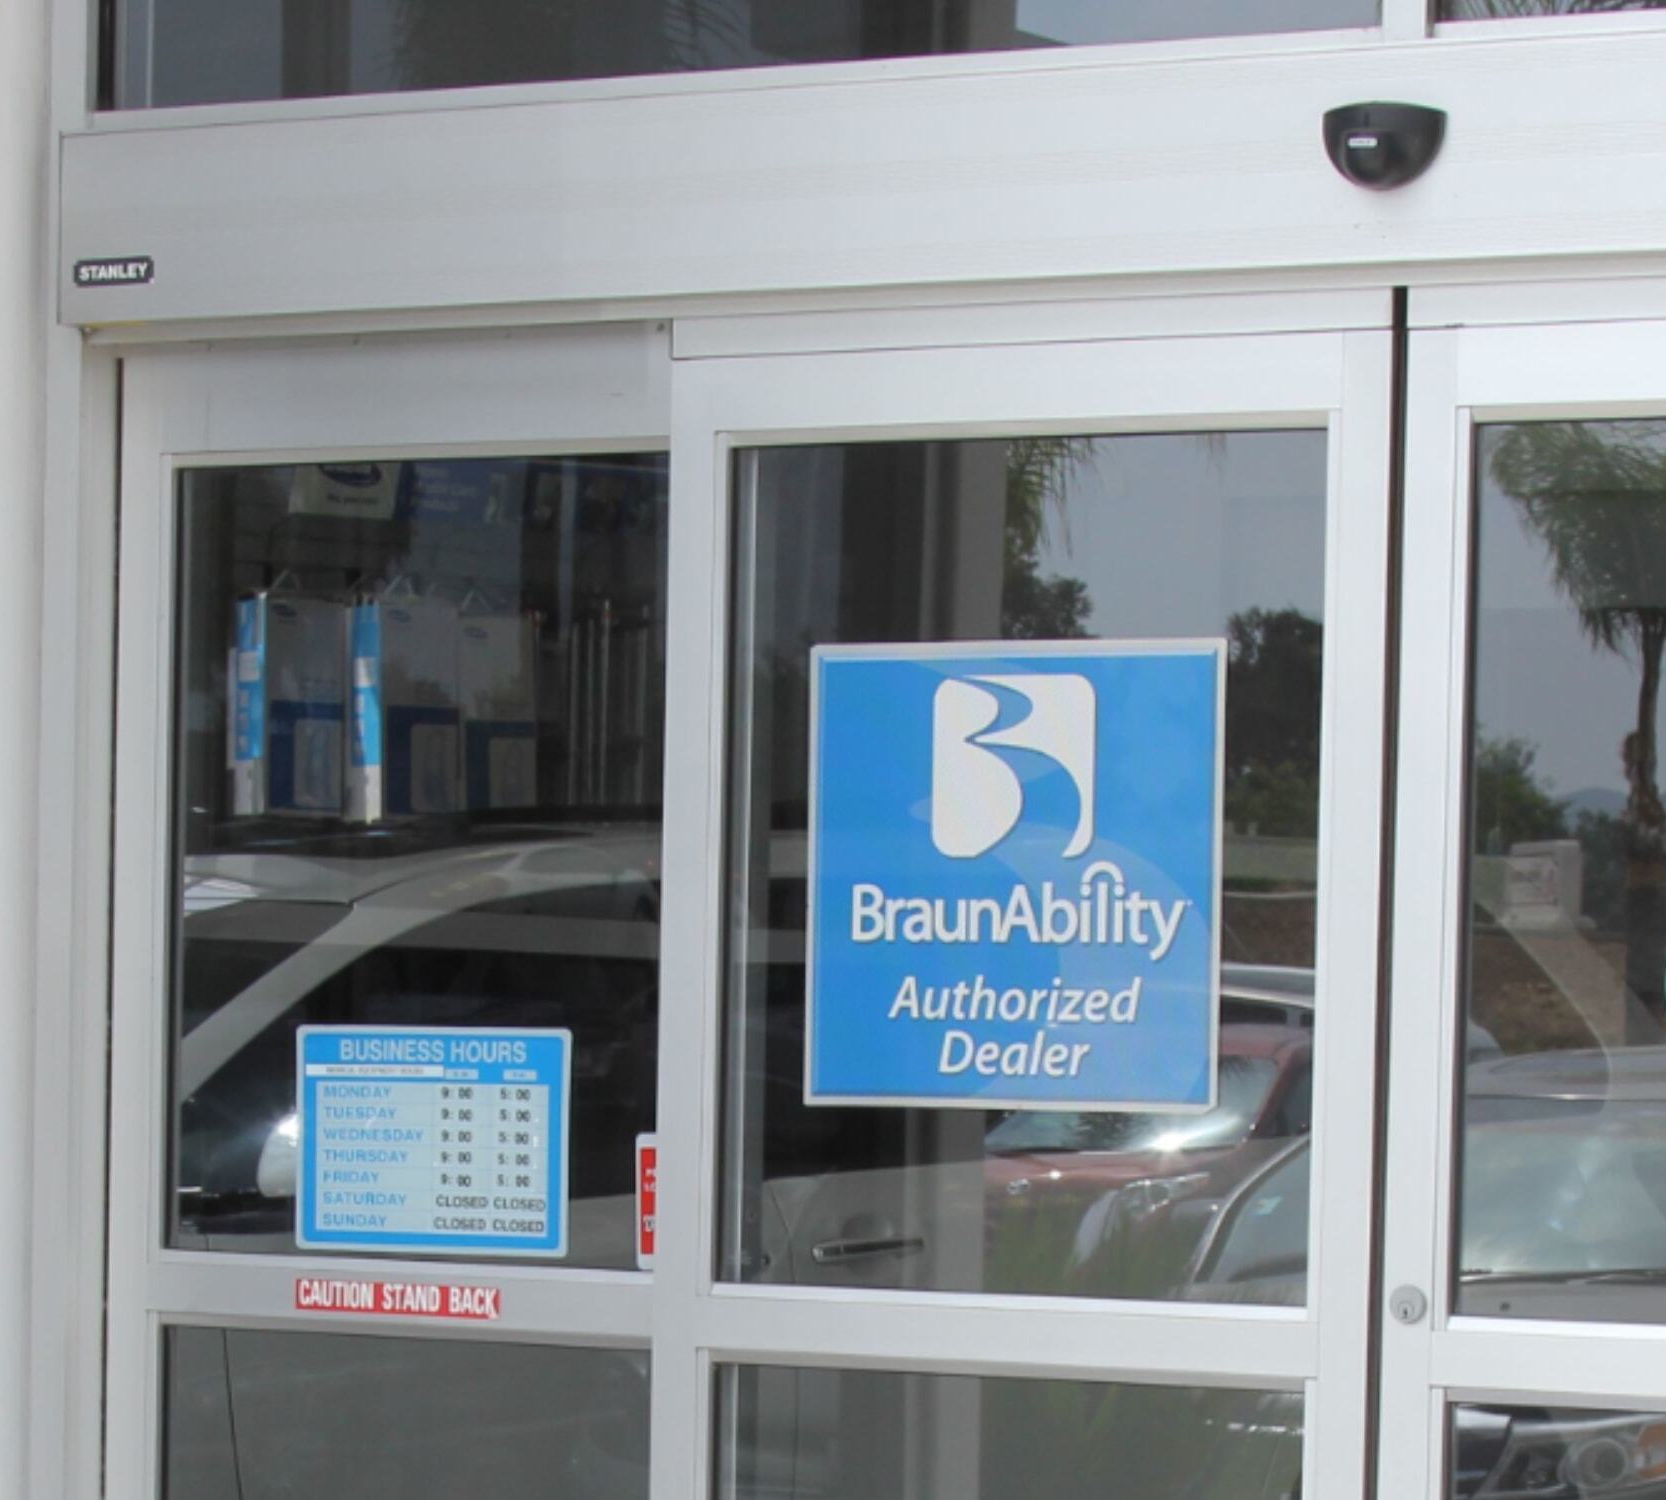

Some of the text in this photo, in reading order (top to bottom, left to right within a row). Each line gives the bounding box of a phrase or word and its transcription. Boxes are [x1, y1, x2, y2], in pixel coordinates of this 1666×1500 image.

[79, 262, 148, 281] STANLEY
[851, 862, 1183, 961] BraunAbility
[888, 974, 1141, 1023] Authorized
[339, 1039, 527, 1063] BUSINESS HOURS
[938, 1029, 1091, 1079] Dealer
[324, 1086, 390, 1098] MONDAY
[324, 1107, 395, 1120] TUESDAY
[324, 1129, 423, 1141] WEDNESDAY
[324, 1150, 408, 1163] THURSDAY
[324, 1171, 379, 1184] FRIDAY
[323, 1192, 546, 1212] SATURDAY CLOSED CLOSED
[323, 1214, 544, 1233] SUNDAY CLOSED CLOSED
[297, 1279, 500, 1318] CAUTION STAND BACK
